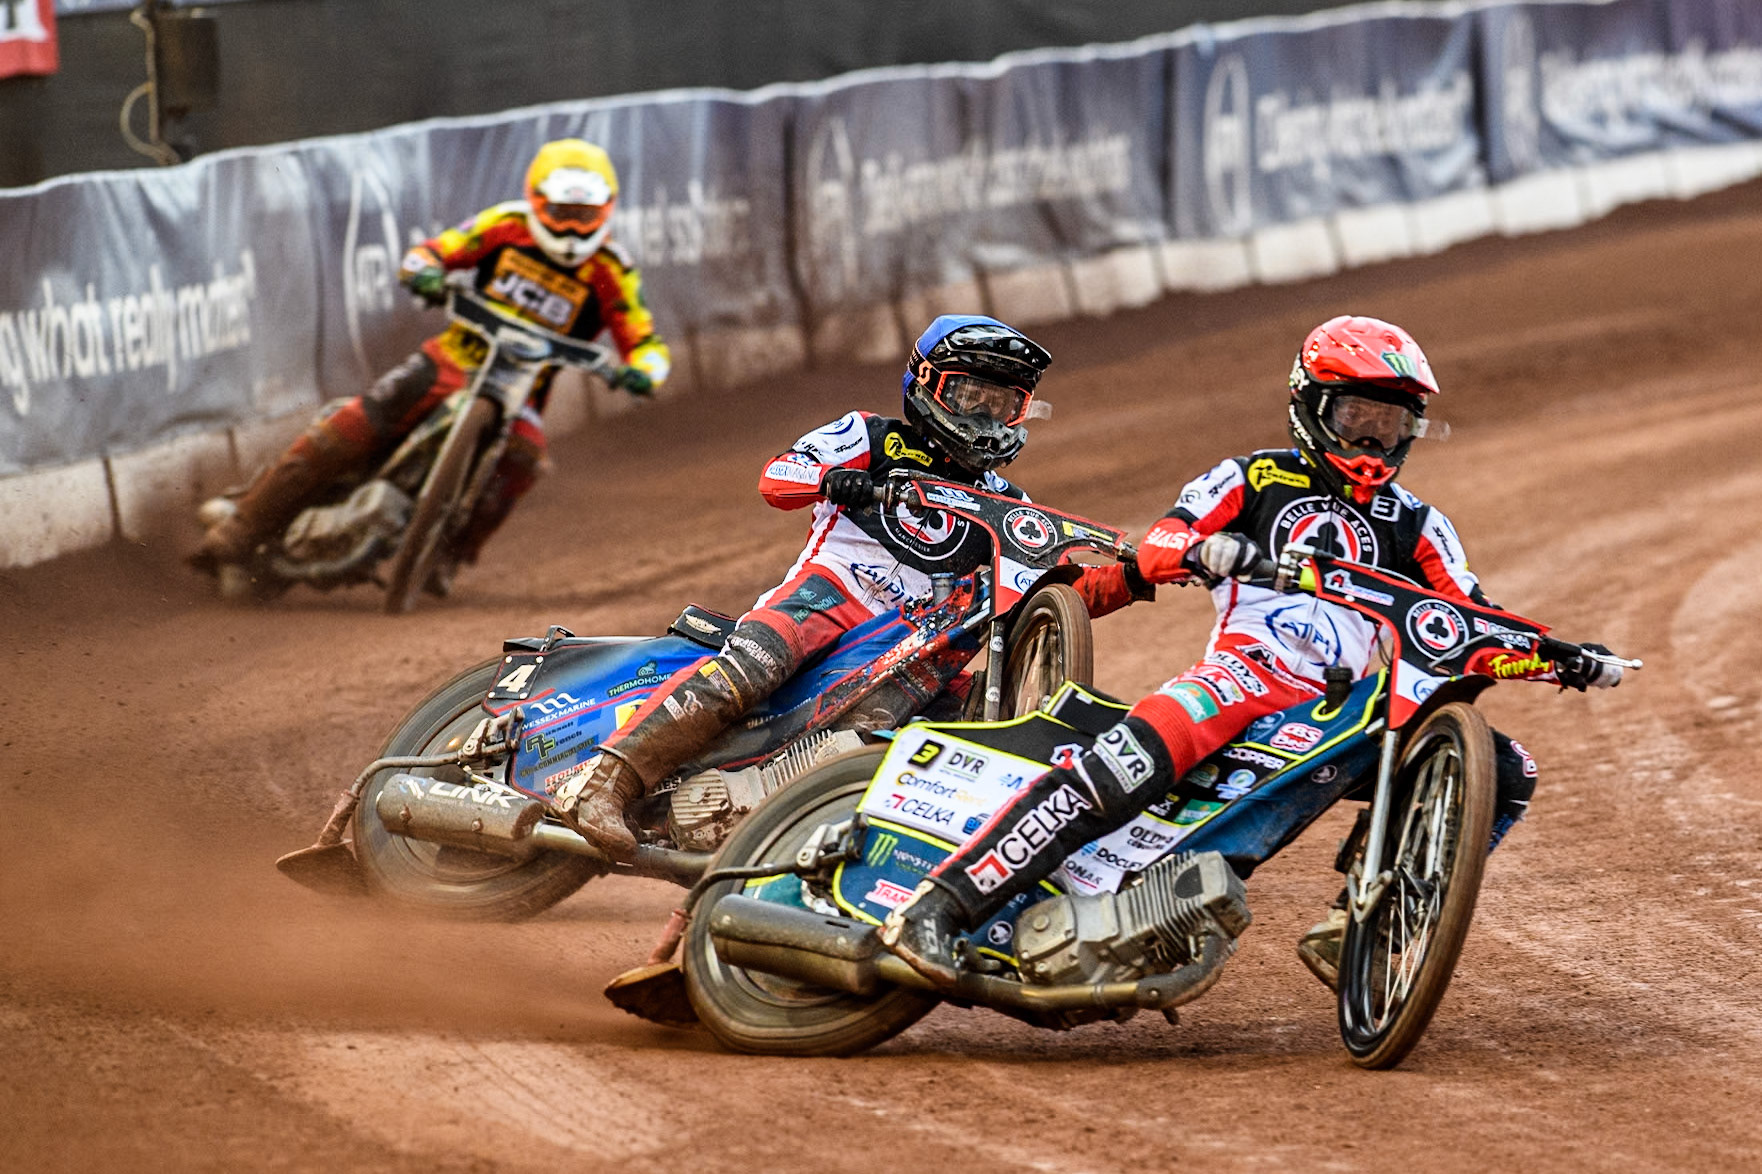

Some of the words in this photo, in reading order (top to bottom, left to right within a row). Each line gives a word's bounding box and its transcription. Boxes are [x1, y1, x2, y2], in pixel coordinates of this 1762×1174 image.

[493, 273, 573, 326] JCB
[1280, 502, 1316, 530] BELLE
[1321, 502, 1350, 518] VUE
[1350, 519, 1373, 553] ACES
[497, 664, 537, 693] 4
[522, 712, 558, 731] WESSEX
[558, 698, 596, 718] MARINE
[911, 743, 940, 764] 3
[948, 752, 985, 774] DVR
[1103, 729, 1147, 780] DVR
[428, 782, 520, 809] LINK
[902, 798, 955, 825] CELKA
[1001, 786, 1091, 867] CELKA
